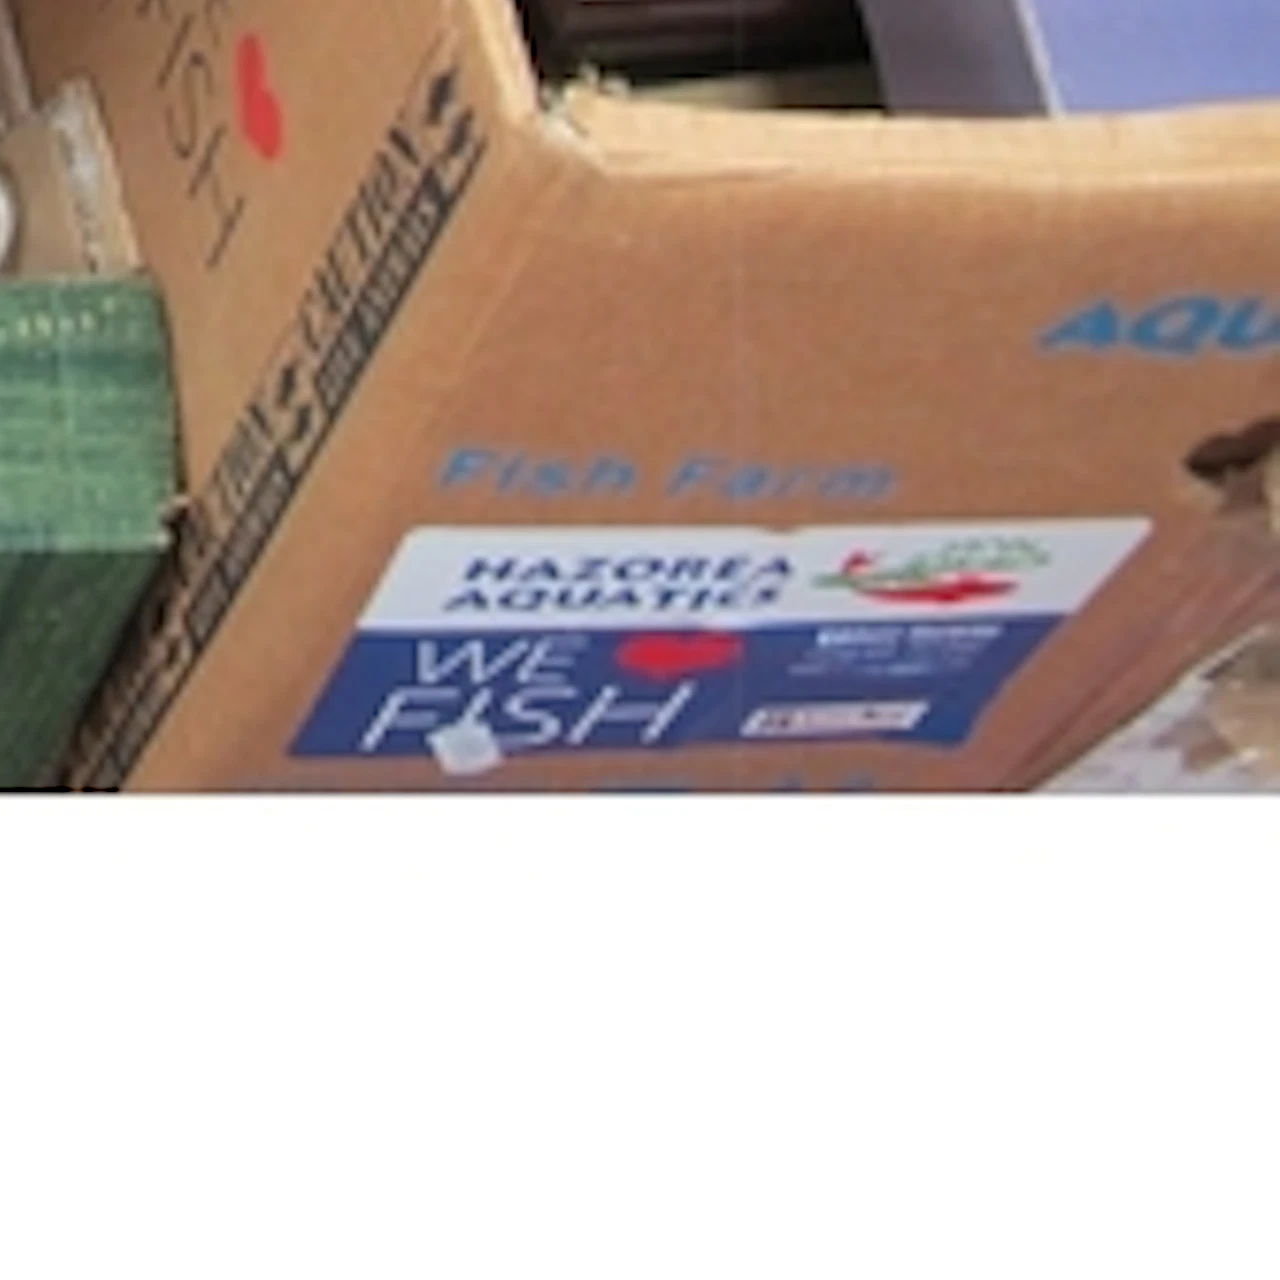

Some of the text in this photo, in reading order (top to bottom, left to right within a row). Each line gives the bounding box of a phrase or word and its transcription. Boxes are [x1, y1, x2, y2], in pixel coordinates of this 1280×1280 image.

[442, 446, 898, 502] Fish Farm
[463, 557, 794, 582] HAZOREA
[443, 588, 786, 612] AQUATICS
[414, 638, 585, 683] WE
[358, 682, 692, 752] FISH
